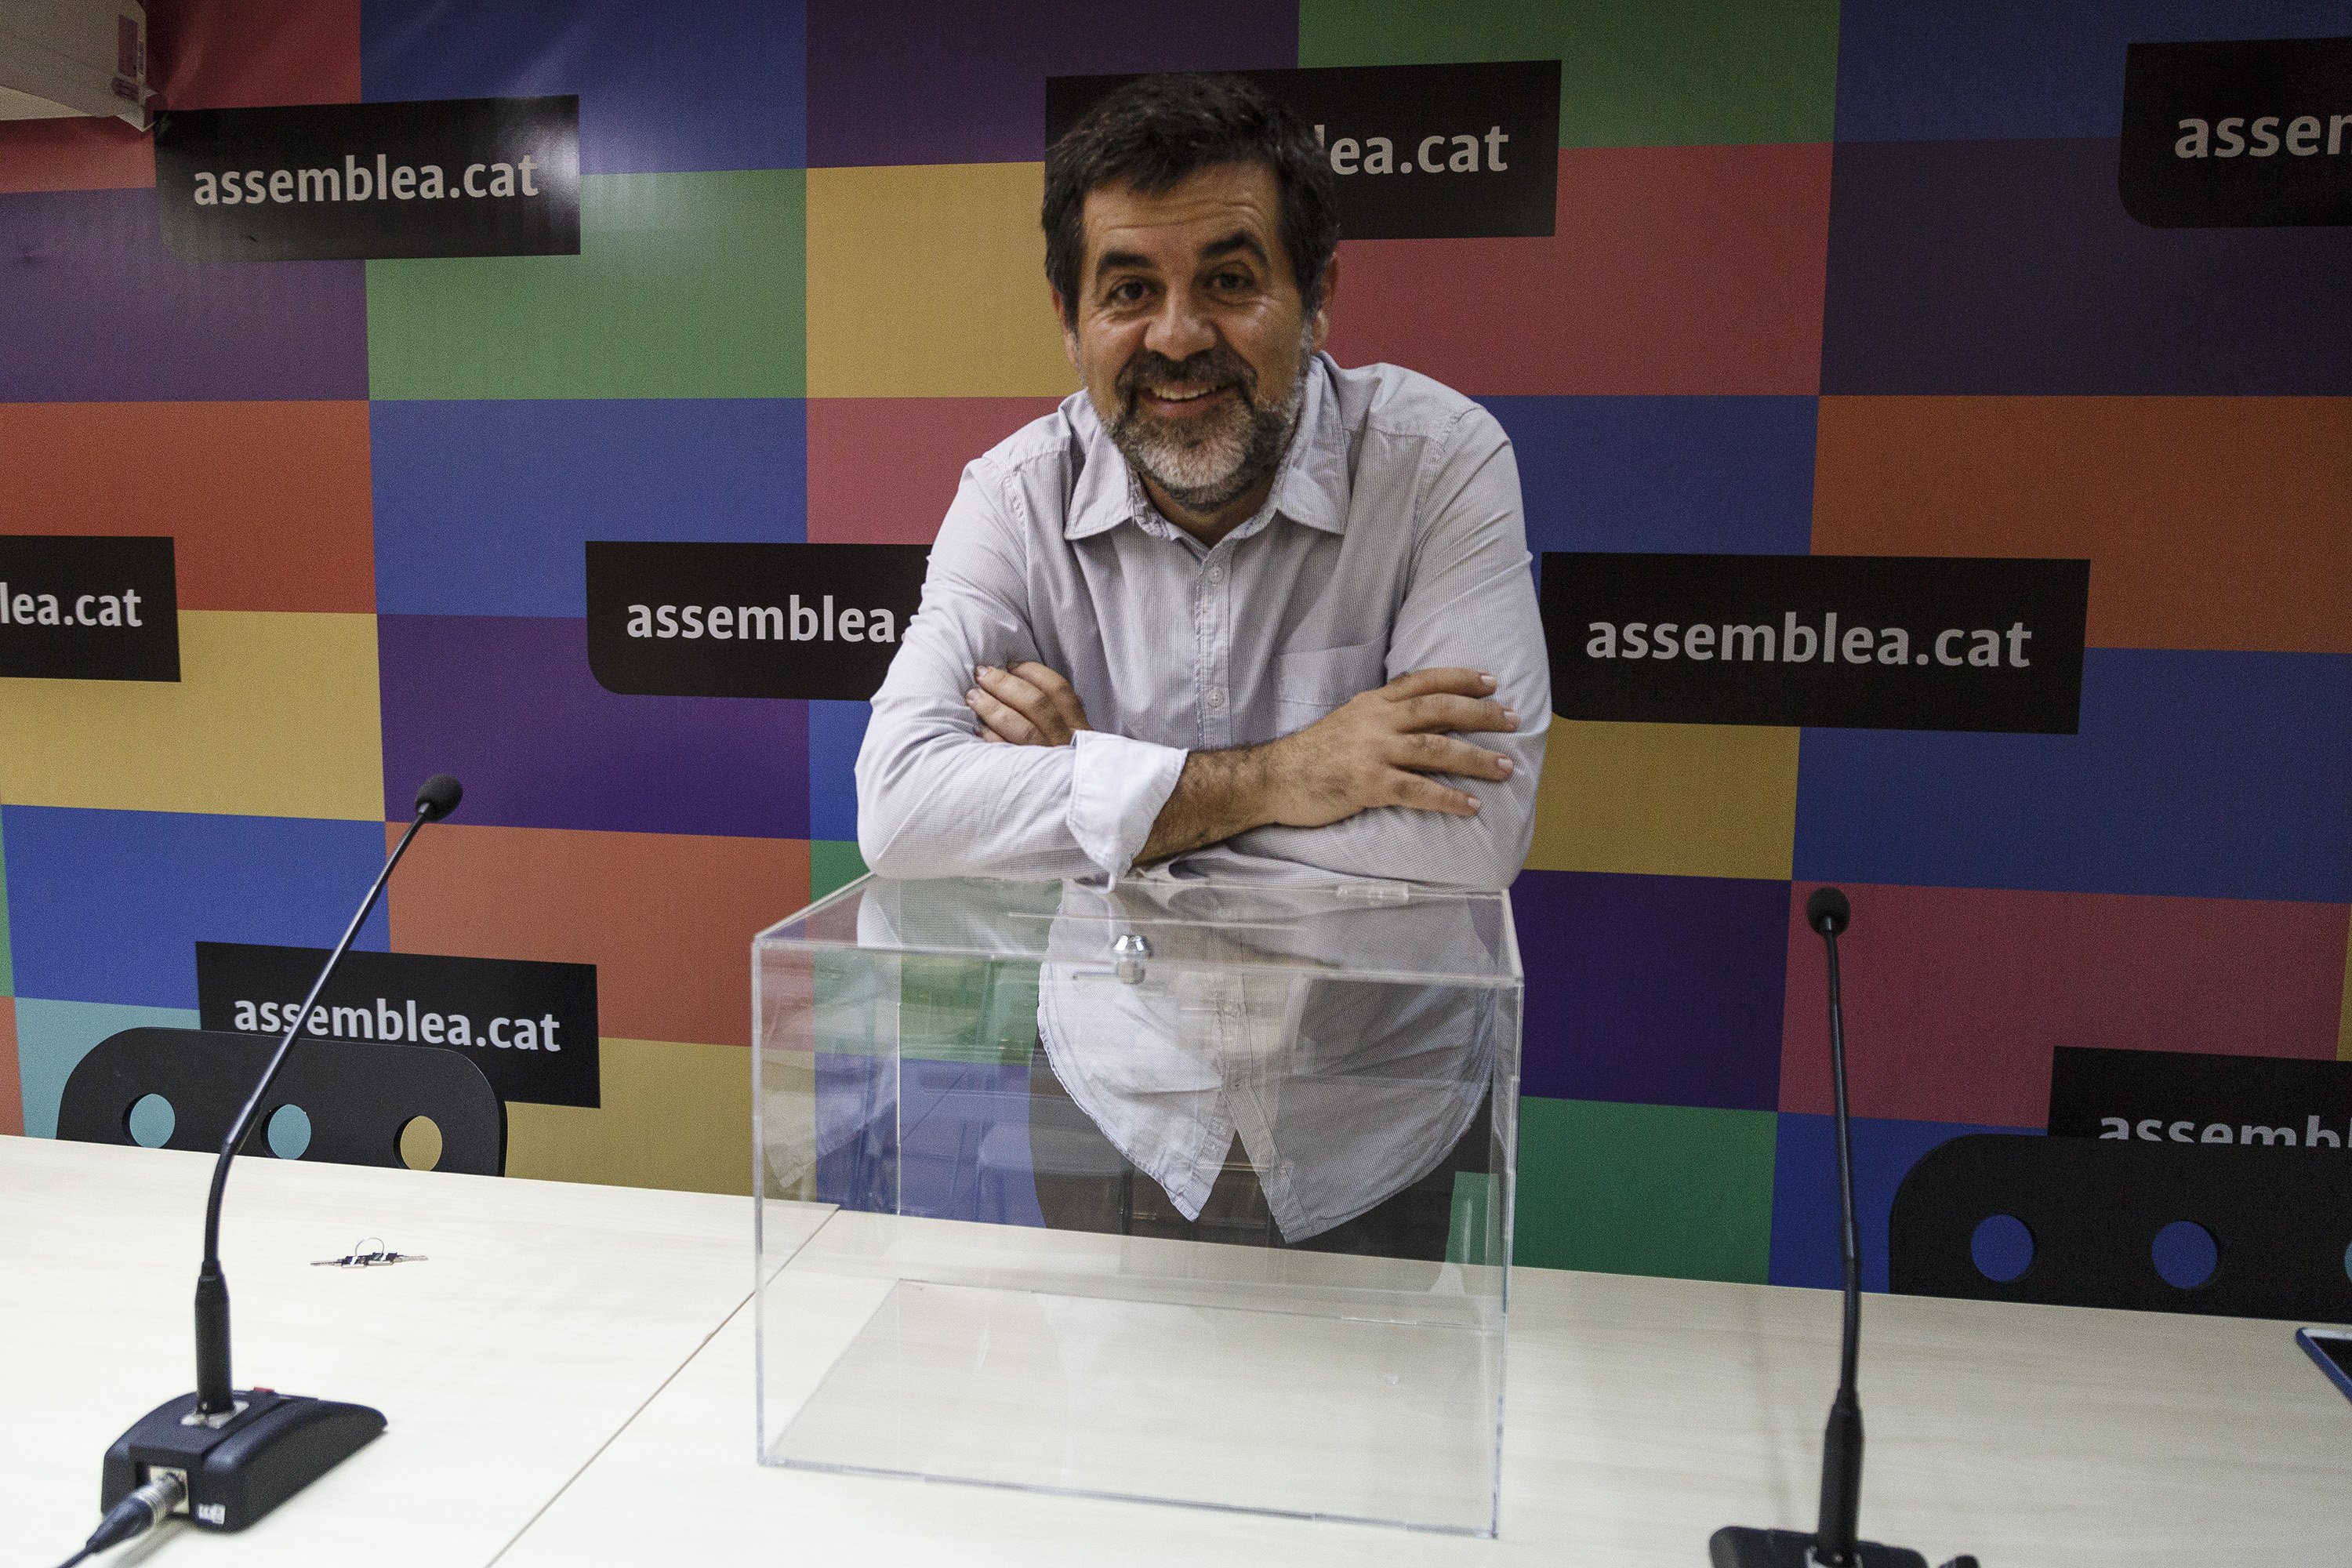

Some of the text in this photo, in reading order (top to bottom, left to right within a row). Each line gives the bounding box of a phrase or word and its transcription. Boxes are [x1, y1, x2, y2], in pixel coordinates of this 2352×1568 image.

[193, 154, 540, 206] assemblea.cat
[0, 581, 143, 627] lea.cat
[1585, 611, 2032, 668] assemblea.cat
[234, 997, 561, 1052] assemblea.cat
